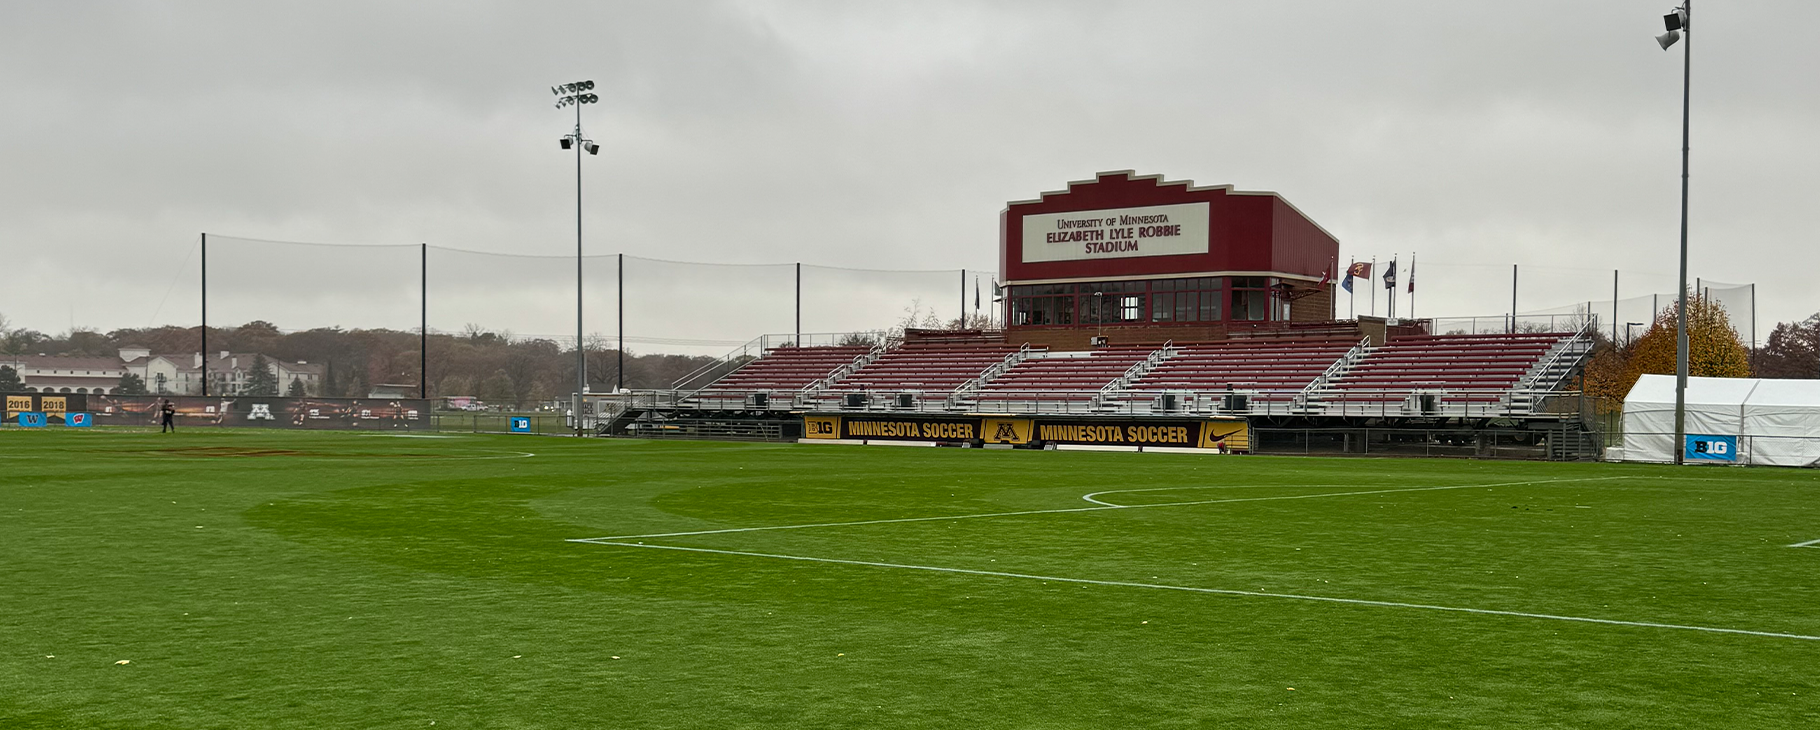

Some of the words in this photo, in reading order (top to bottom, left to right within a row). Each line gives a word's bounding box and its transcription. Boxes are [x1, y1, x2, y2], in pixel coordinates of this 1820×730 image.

[1046, 229, 1104, 243] ELIZABETH
[1109, 228, 1134, 240] LYLE
[1138, 224, 1181, 238] ROBBIE
[1085, 240, 1139, 254] STADIUM
[8, 400, 30, 409] 2016
[43, 401, 65, 410] 2018
[848, 421, 920, 438] MINNESOTA
[923, 422, 974, 439] SOCCER
[1039, 424, 1124, 443] MINNESOTA
[1127, 425, 1188, 444] SOCCER
